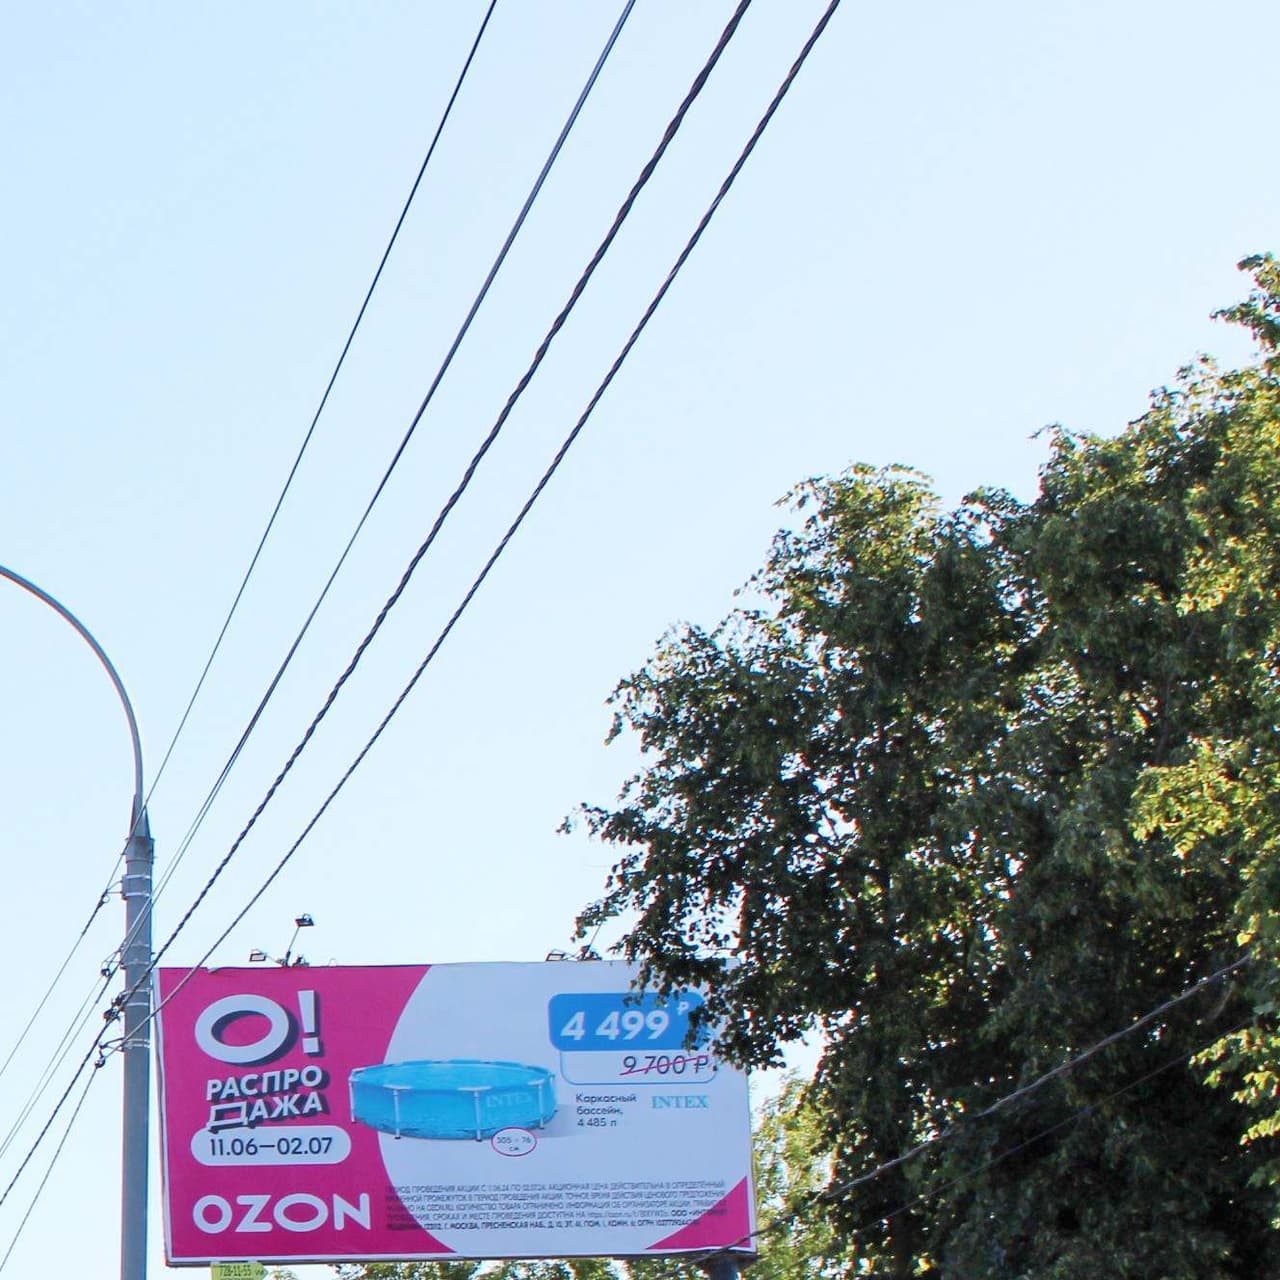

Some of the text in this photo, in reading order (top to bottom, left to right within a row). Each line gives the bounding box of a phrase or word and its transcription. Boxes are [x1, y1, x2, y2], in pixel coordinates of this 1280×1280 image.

[595, 1009, 670, 1041] 499
[206, 1065, 324, 1101] РАСПРО
[575, 1092, 637, 1104] Каркасный
[206, 1091, 324, 1130] ДАЖА
[652, 1095, 709, 1109] INTEX
[193, 1193, 371, 1234] OZON
